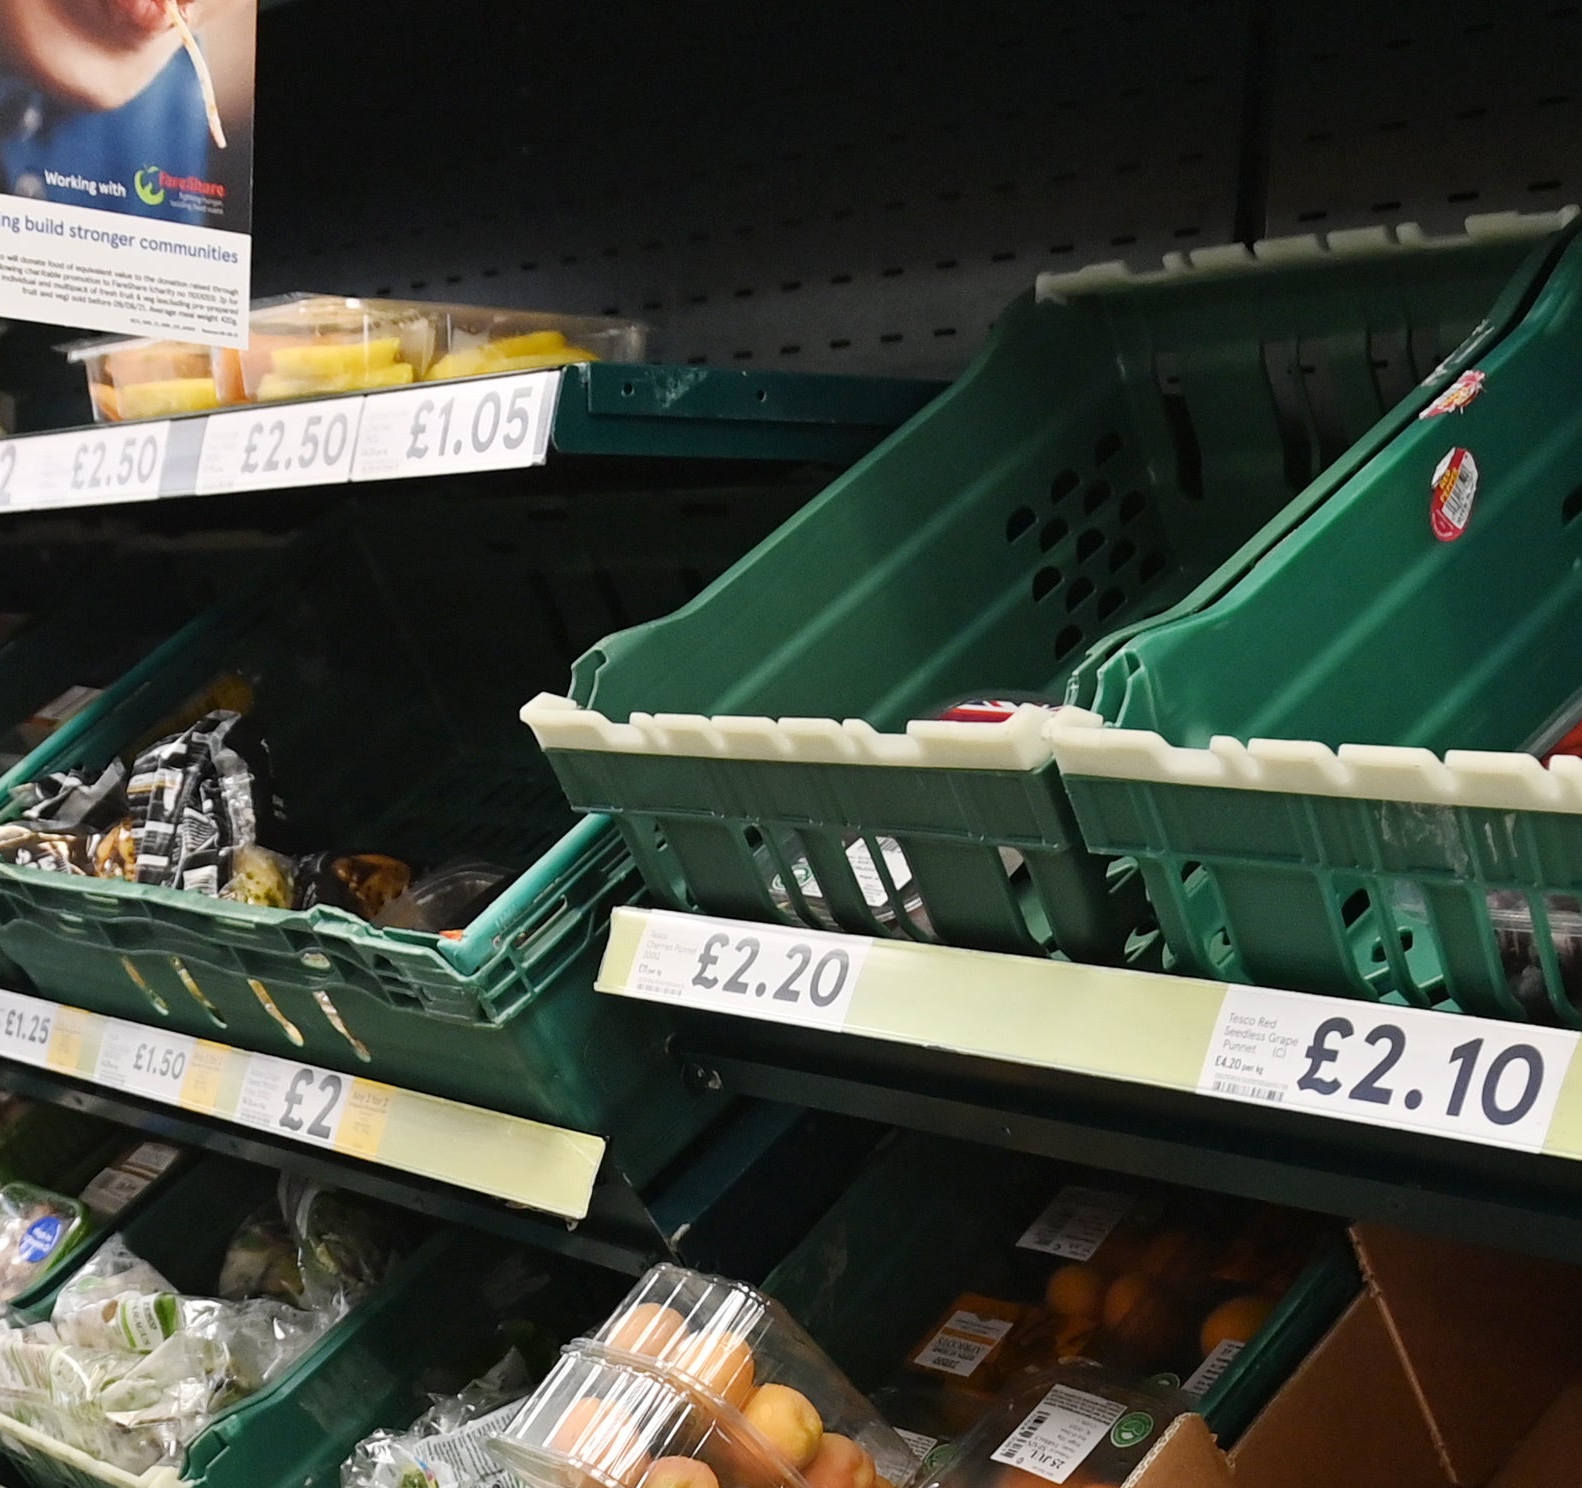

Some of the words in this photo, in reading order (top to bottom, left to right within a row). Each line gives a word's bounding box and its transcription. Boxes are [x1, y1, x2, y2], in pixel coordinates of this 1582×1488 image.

[44, 169, 97, 196] Working
[99, 182, 127, 198] with
[24, 214, 64, 237] build
[69, 225, 135, 249] stronger
[139, 237, 239, 264] communities
[406, 386, 534, 460] £1.05
[240, 412, 349, 475] £2.50
[70, 435, 158, 491] £2.50
[692, 933, 850, 1007] £2.20
[4, 1008, 52, 1045] £1.25
[1224, 1025, 1266, 1042] Seedless
[1268, 1030, 1298, 1047] Grape
[1229, 1013, 1256, 1026] Tesco
[1258, 1017, 1277, 1029] Red
[132, 1043, 186, 1081] £1.50
[1214, 1056, 1242, 1070] £4.20
[1242, 1064, 1254, 1072] per
[1223, 1040, 1256, 1054] Punnet
[1273, 1046, 1287, 1059] (C)
[1297, 1017, 1545, 1125] £2.10
[278, 1068, 343, 1140] £2
[1029, 1449, 1048, 1464] JUL
